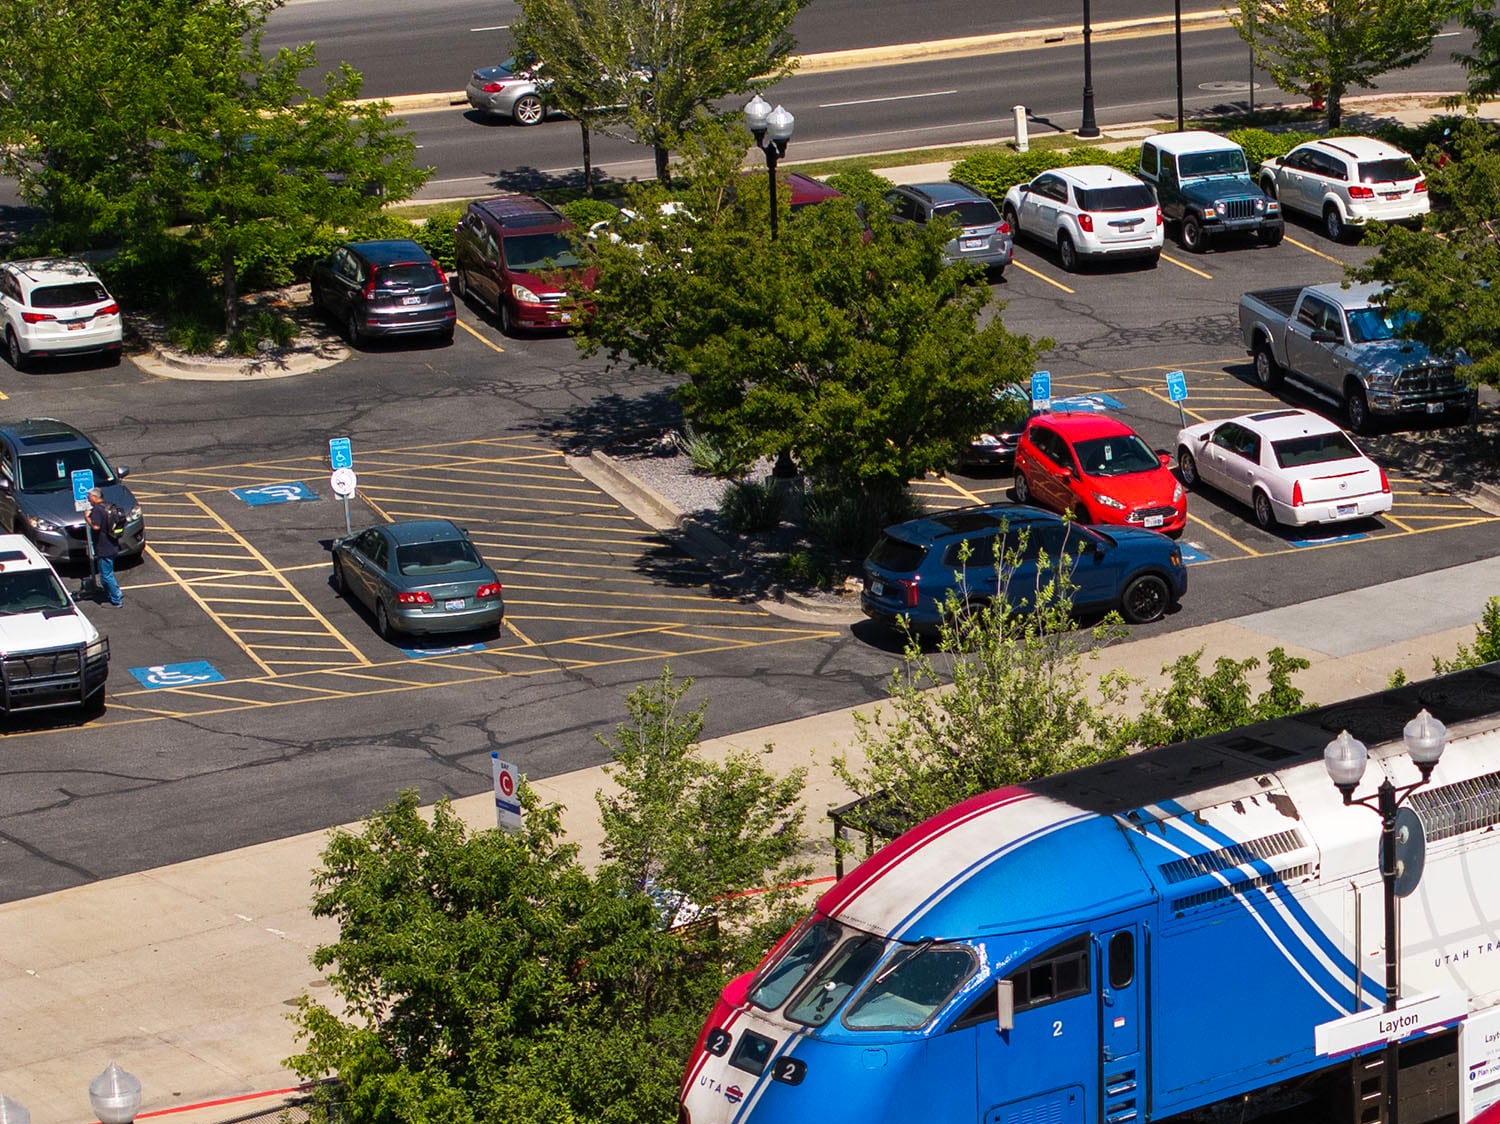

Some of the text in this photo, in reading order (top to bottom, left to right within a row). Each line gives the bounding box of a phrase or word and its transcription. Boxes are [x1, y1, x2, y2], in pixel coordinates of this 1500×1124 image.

[502, 775, 511, 792] C
[1434, 949, 1469, 967] UTAH
[1053, 1020, 1063, 1037] 2
[1379, 1012, 1419, 1034] Layton
[712, 1035, 725, 1051] 2
[782, 1063, 796, 1080] 2
[700, 1075, 721, 1093] UTA
